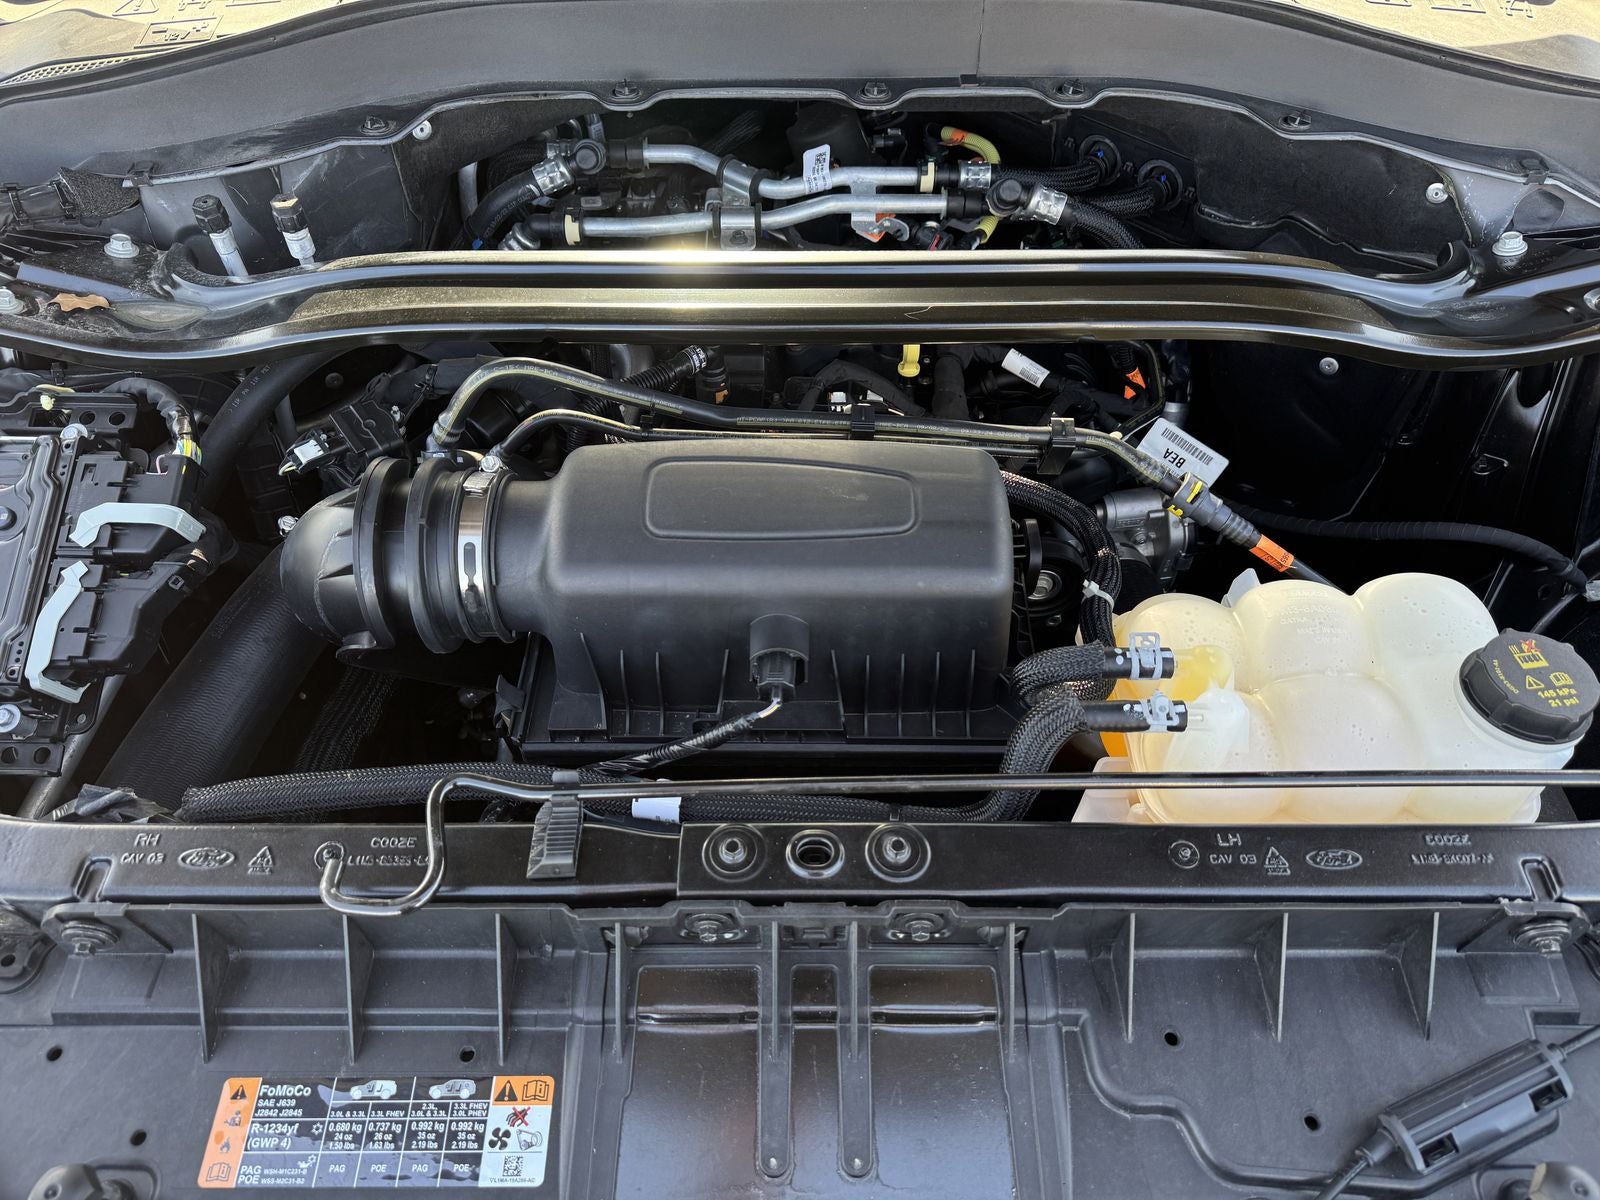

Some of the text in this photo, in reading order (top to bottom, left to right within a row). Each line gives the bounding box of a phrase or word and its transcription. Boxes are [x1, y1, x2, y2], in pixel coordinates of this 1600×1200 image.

[1163, 448, 1186, 468] BEA
[1538, 688, 1577, 699] 145 kPa
[1548, 697, 1579, 707] 21 psi
[134, 833, 160, 846] RH
[1217, 833, 1242, 847] LH
[1209, 854, 1232, 864] CAV
[260, 1084, 312, 1097] FoMoCo
[257, 1099, 296, 1107] SAE J639
[453, 1102, 488, 1110] 3.3L FHEV
[254, 1109, 303, 1117] J2842 J2845
[330, 1110, 366, 1118] 3.0L & 3.3L
[370, 1110, 405, 1118] 3.3L FHEV
[410, 1110, 447, 1118] 3.0L & 3.3L
[452, 1110, 487, 1118] 3.0L PHEV
[250, 1122, 300, 1137] R-1234yf
[328, 1121, 363, 1134] 0.680 kg
[368, 1121, 402, 1134] 0.737 kg
[411, 1121, 445, 1133] 0.992 kg
[450, 1121, 485, 1133] 0.992 kg
[334, 1132, 344, 1140] 24
[373, 1132, 383, 1140] 26
[417, 1131, 426, 1140] 35
[456, 1131, 466, 1140] 35
[247, 1137, 292, 1150] (GWP 4)
[328, 1141, 355, 1150] 1.50 lbs
[368, 1141, 395, 1150] 1.63 lbs
[411, 1141, 438, 1149] 2.19 lbs
[451, 1141, 478, 1149] 2.19 lbs
[240, 1165, 262, 1175] PAG
[329, 1164, 346, 1173] PAG
[370, 1164, 387, 1173] POE
[411, 1164, 428, 1173] PAG
[453, 1164, 470, 1172] POE
[238, 1175, 259, 1184] POE
